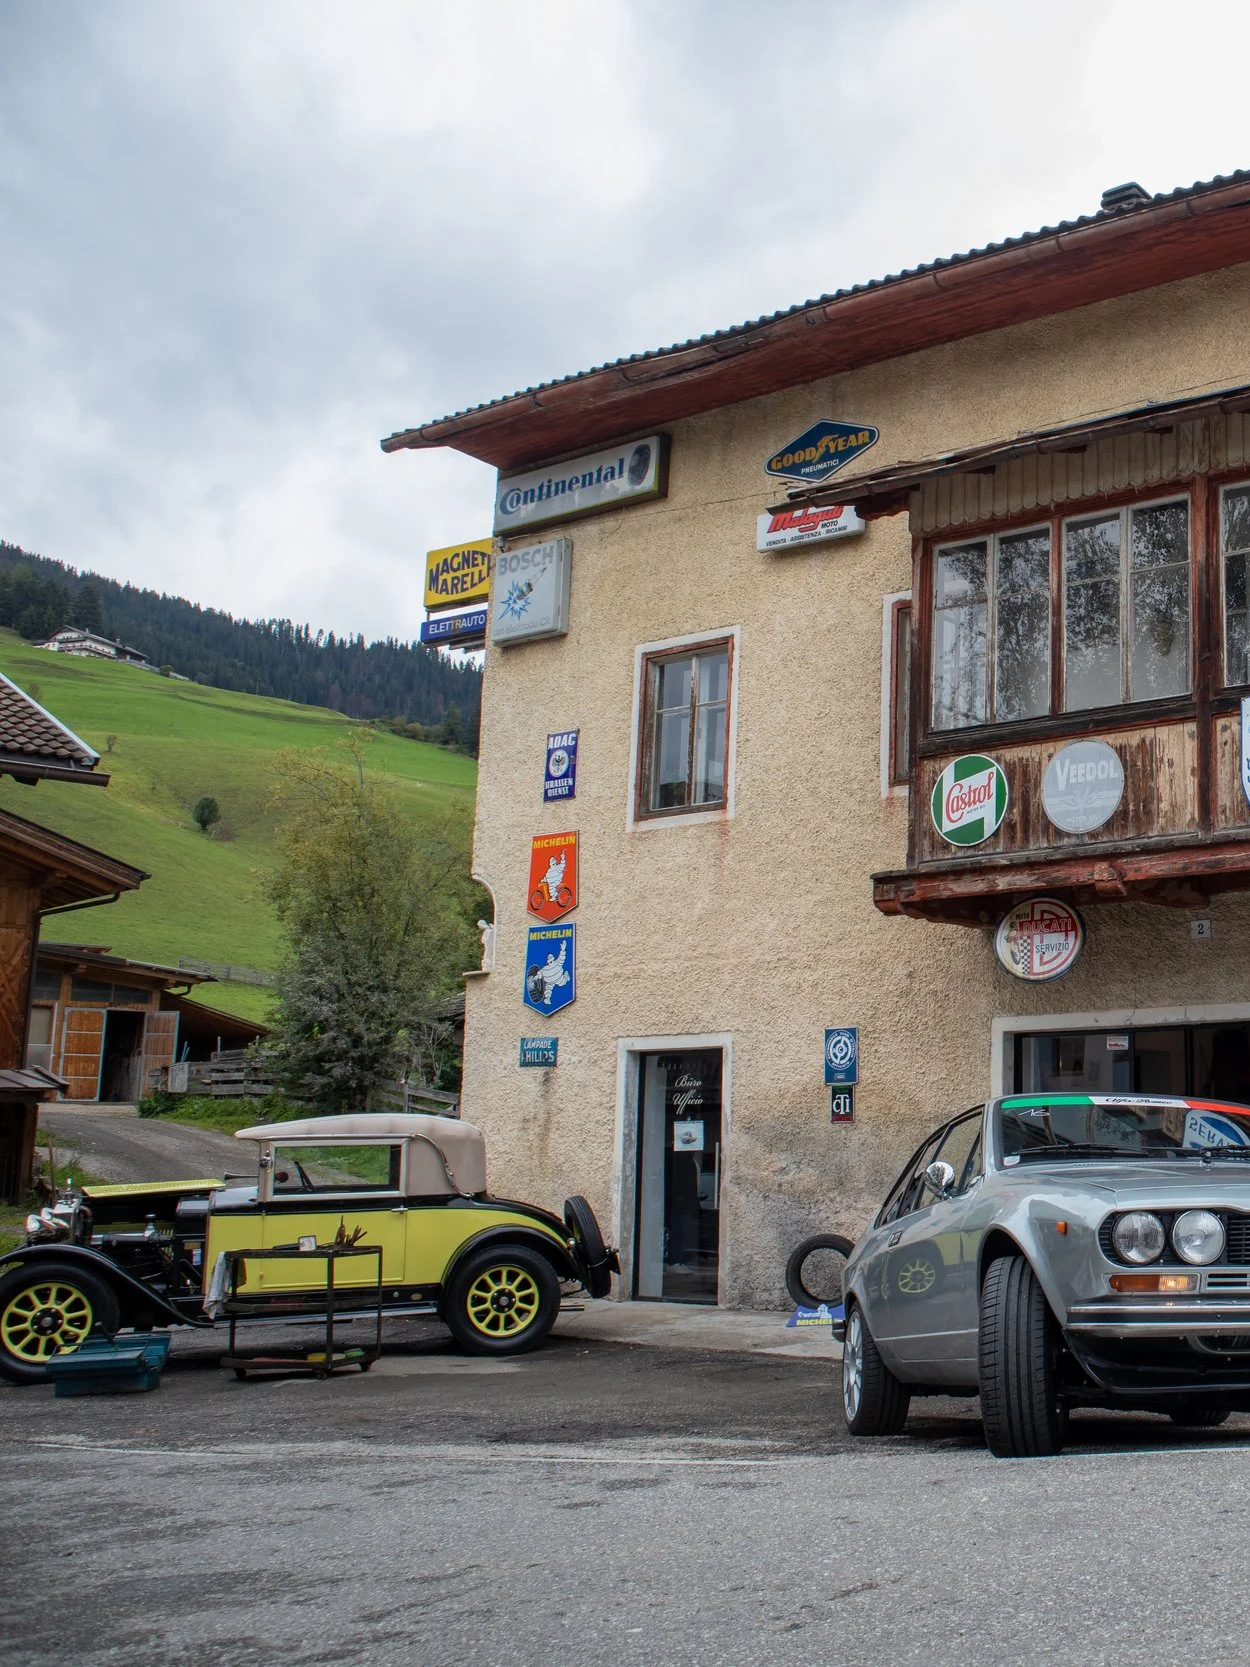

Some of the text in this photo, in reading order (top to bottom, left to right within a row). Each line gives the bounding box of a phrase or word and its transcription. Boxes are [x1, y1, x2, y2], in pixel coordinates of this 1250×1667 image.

[801, 458, 839, 475] PNEUMATICI
[499, 458, 625, 516] Continental
[821, 520, 838, 529] MOTO
[766, 525, 848, 547] VENDITA ASSISTENZA RICAMBI
[498, 545, 554, 577] BOSCH
[429, 614, 486, 635] ELETTRAUTO
[547, 733, 577, 750] ADAC
[945, 771, 995, 824] Castrol
[533, 835, 577, 849] MICHELIN
[1023, 918, 1072, 935] DUCATI
[1197, 923, 1205, 935] 2
[529, 929, 573, 942] MICHELIN
[1035, 942, 1070, 954] SERVIZIO
[523, 1040, 553, 1049] LAMPADE
[674, 1073, 703, 1088] Büro
[672, 1089, 703, 1115] Ufficio
